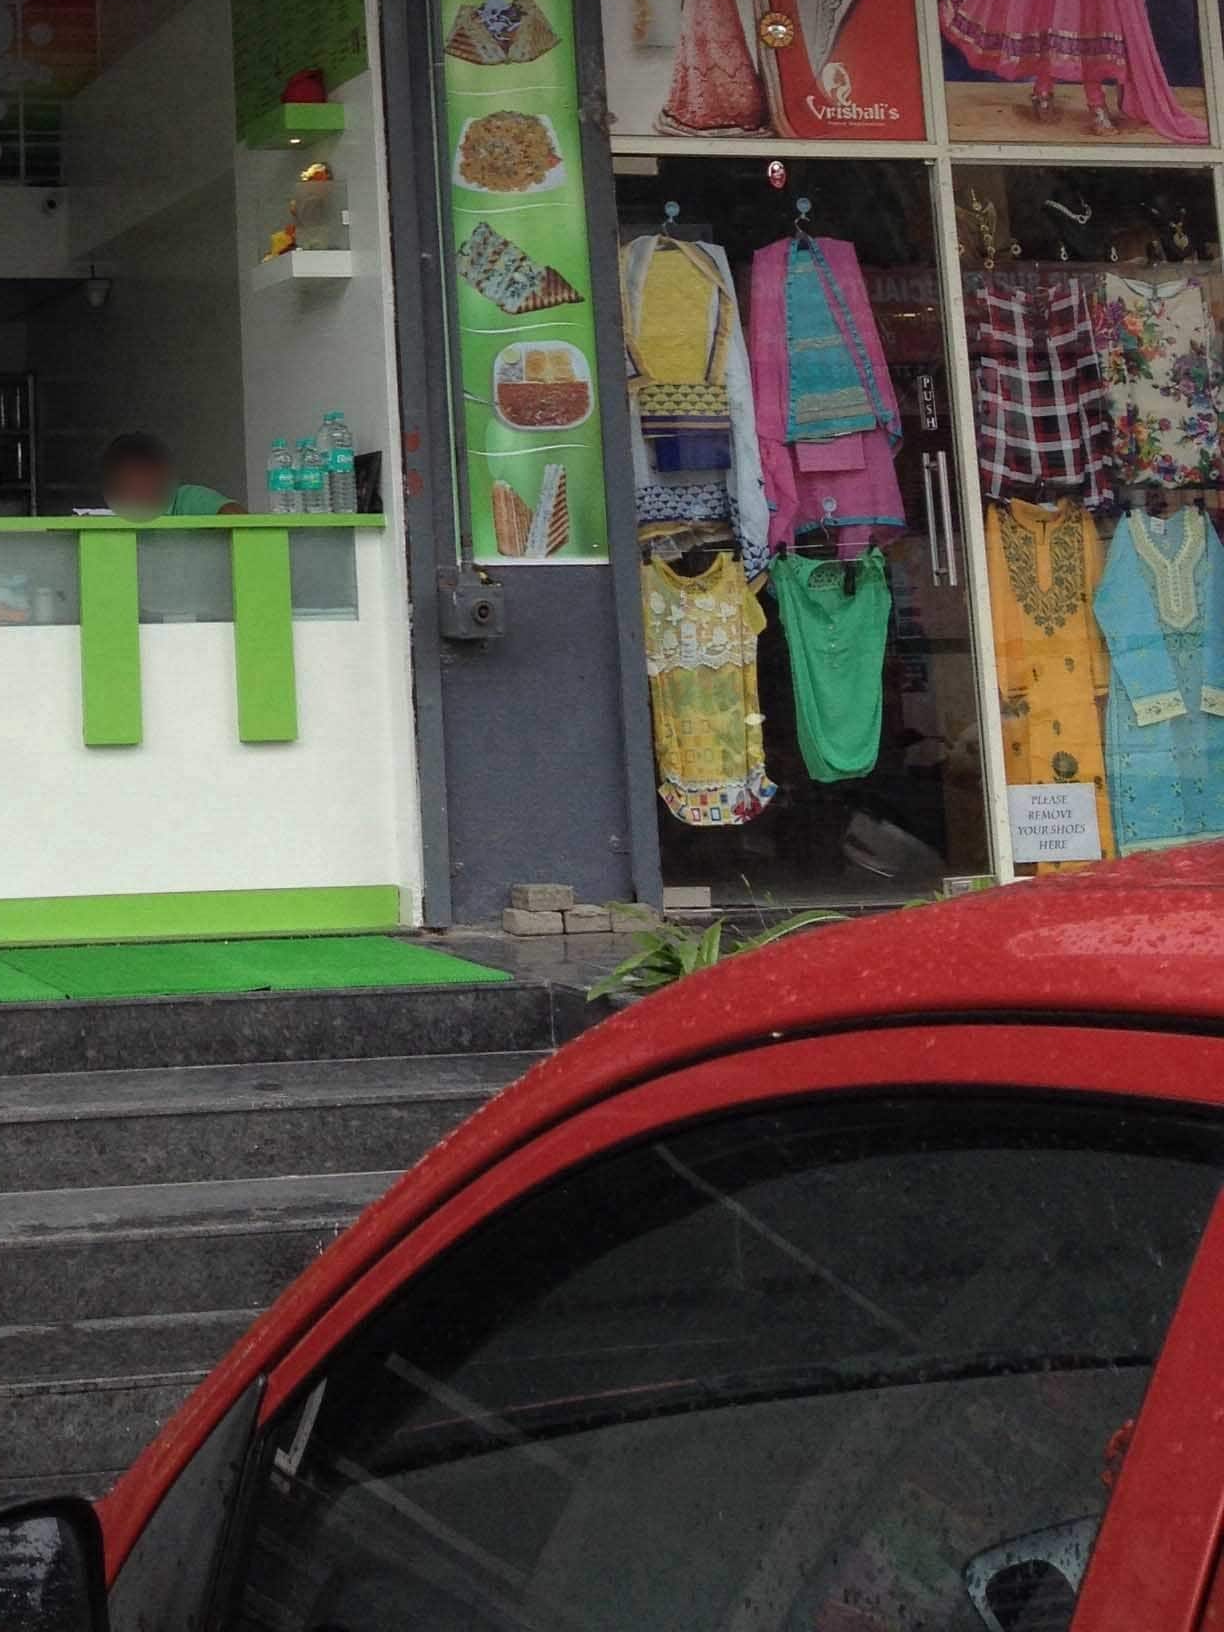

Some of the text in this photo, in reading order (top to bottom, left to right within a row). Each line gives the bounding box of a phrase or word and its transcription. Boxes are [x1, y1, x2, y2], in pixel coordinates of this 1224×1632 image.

[806, 95, 900, 120] Vrishali's
[923, 377, 936, 429] PUSH
[1031, 794, 1067, 806] PLEASE
[1028, 809, 1072, 821] REMOVE
[1017, 823, 1086, 837] YOUR SHOES
[1039, 840, 1067, 851] HERE
